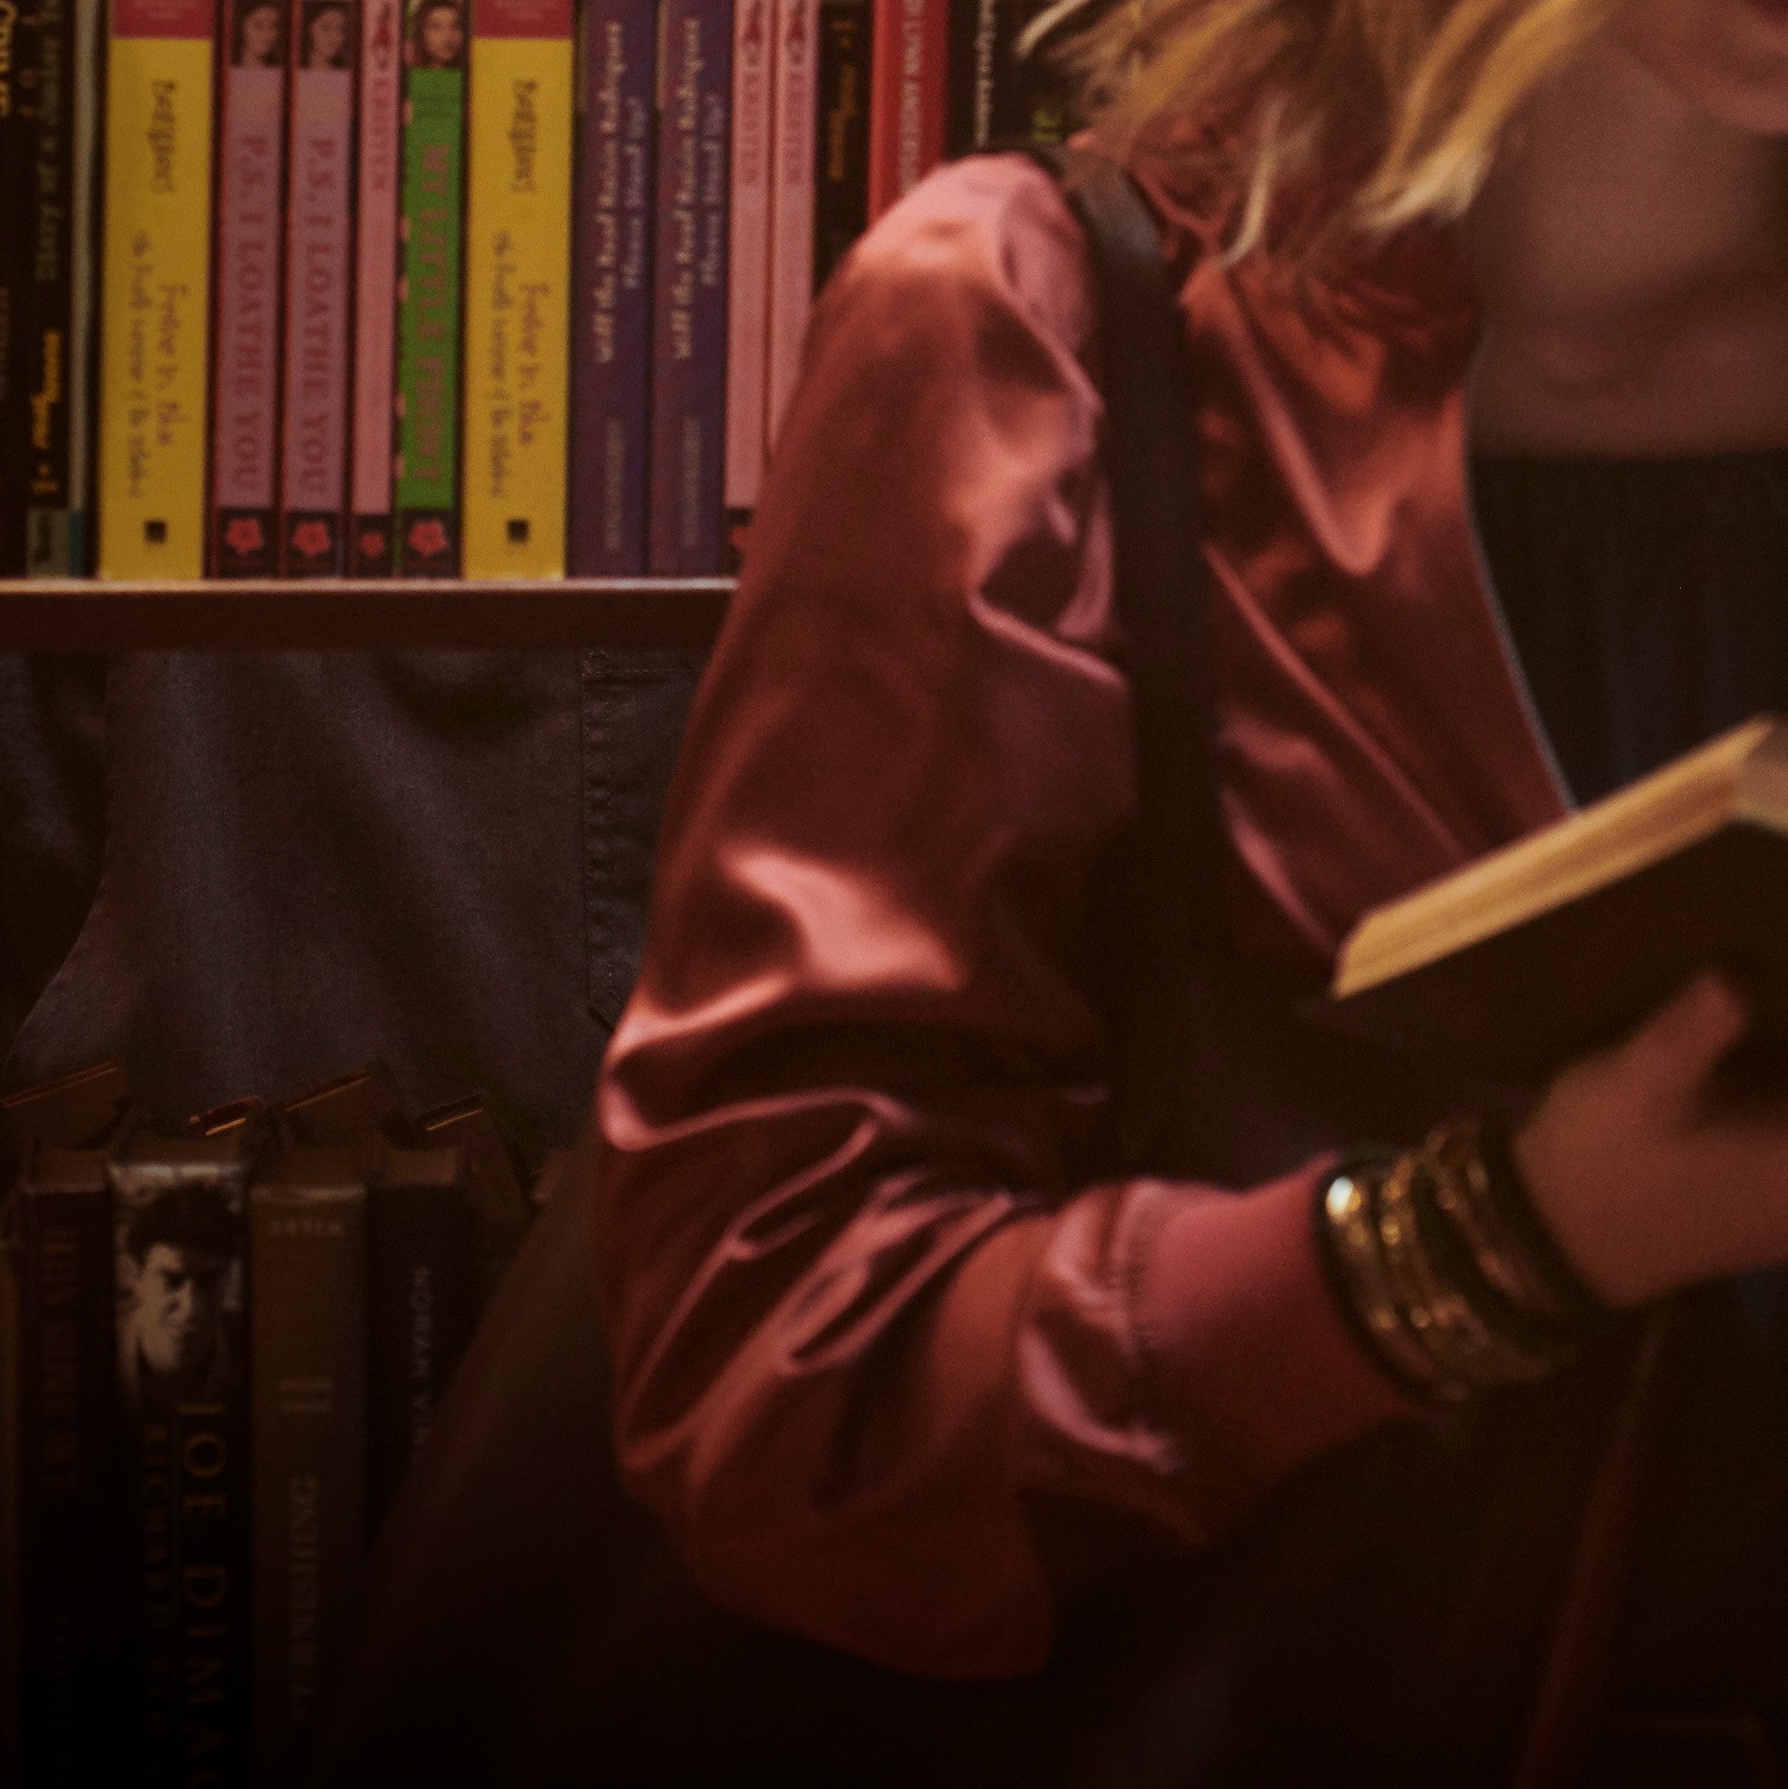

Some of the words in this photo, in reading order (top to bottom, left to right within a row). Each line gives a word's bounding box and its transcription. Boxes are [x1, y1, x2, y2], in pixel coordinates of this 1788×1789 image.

[234, 241, 264, 396] LOATHE
[303, 242, 333, 399] LOATHE
[231, 409, 262, 493] YOU
[300, 411, 330, 495] YOU
[144, 1423, 169, 1632] RICHARD
[176, 1401, 228, 1520] JOE
